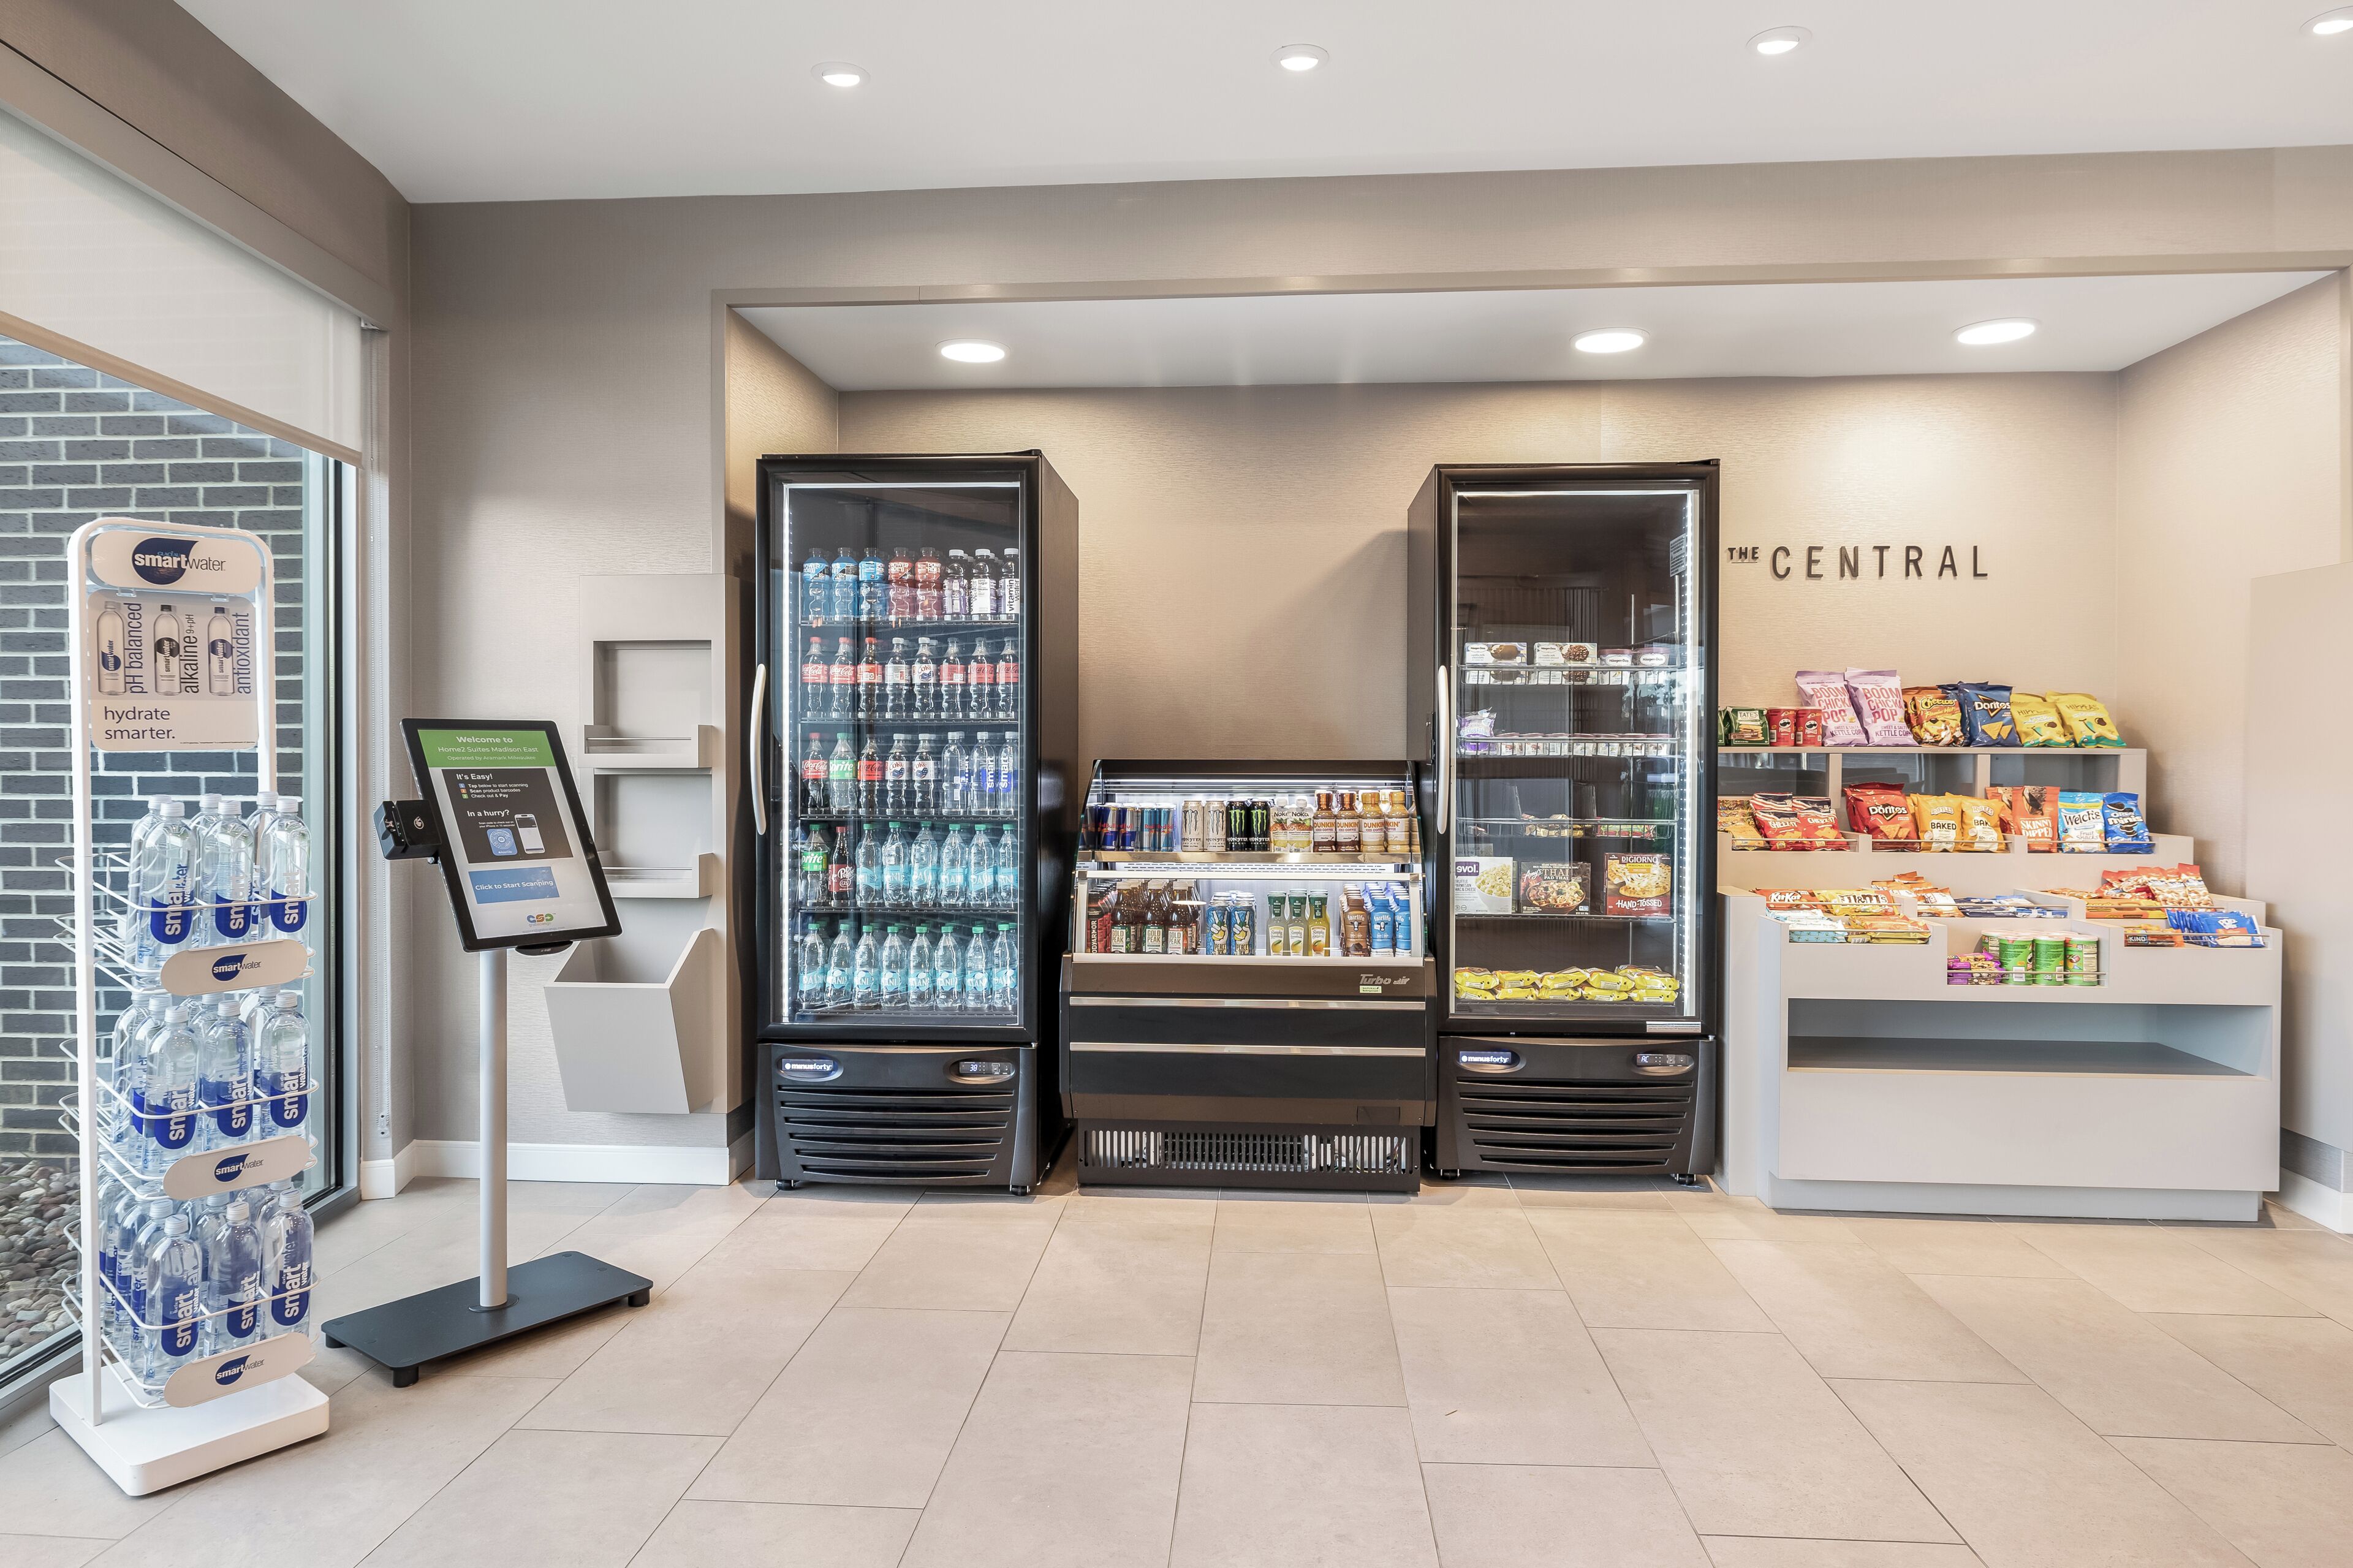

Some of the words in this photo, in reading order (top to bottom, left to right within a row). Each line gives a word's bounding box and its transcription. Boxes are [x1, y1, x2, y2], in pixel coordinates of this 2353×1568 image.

[134, 553, 226, 571] smartwater
[1727, 547, 1759, 560] THE
[1771, 545, 1988, 578] CENTRAL
[123, 602, 144, 670] balanced
[232, 613, 251, 694] antioxidant
[180, 635, 200, 694] alkaline
[125, 673, 148, 694] pH
[1811, 687, 1849, 699] BOOM
[1862, 687, 1901, 700] BOOM
[1921, 698, 1955, 708] Cheetos
[1974, 701, 2010, 711] Doritos
[104, 705, 170, 724] hydrate
[1822, 710, 1847, 724] POP
[1872, 708, 1898, 724] POP
[105, 727, 175, 740] smarter.
[1869, 806, 1908, 815] Doritos
[1931, 806, 1954, 815] RUFFLES
[2064, 810, 2101, 826] Welch's
[2020, 819, 2052, 830] SKINNY
[2107, 816, 2144, 826] minis
[2022, 828, 2052, 838] DIPPED
[1524, 868, 1543, 882] Amy's
[1615, 898, 1662, 909] HAND-TOSSED
[213, 960, 262, 974] smartwater
[1360, 974, 1392, 985] Turbo
[232, 1072, 248, 1129] smart
[215, 1158, 263, 1175] smartwater
[284, 1263, 302, 1318] smart
[241, 1272, 257, 1330] smart
[176, 1289, 194, 1349] smart
[216, 1358, 265, 1379] smartwater
